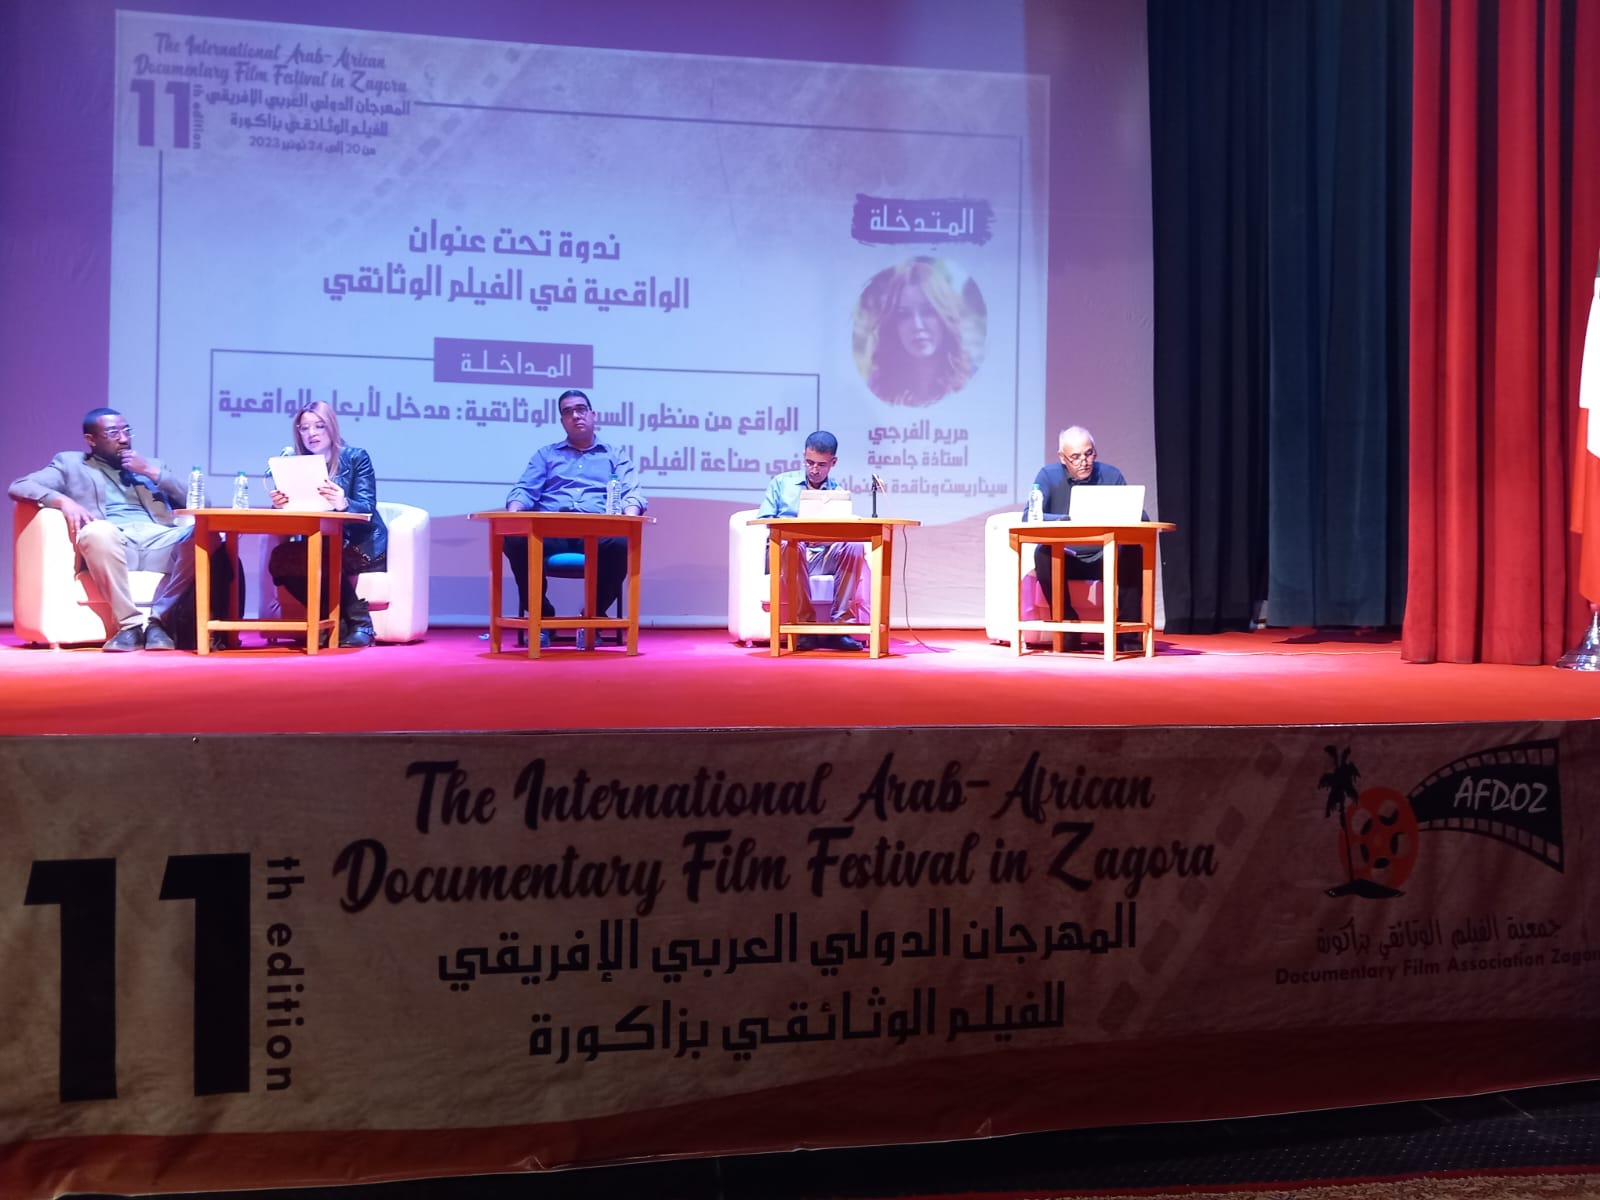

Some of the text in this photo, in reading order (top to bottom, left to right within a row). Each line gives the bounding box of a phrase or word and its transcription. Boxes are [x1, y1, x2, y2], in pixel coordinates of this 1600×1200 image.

[153, 32, 180, 54] The
[185, 34, 282, 60] International
[332, 46, 386, 70] African
[134, 53, 229, 85] Documentary
[235, 61, 268, 83] Film
[331, 73, 345, 88] in
[350, 70, 408, 97] Zagora
[129, 78, 190, 149] 11
[265, 92, 308, 110] العربي
[310, 94, 353, 113] الدولي
[355, 96, 411, 117] المهرجان
[230, 112, 389, 138] للفيلم الوثائقي بزاكورة
[249, 135, 281, 148] 2023
[345, 143, 361, 154] 20
[870, 204, 974, 236] المتدخلة
[408, 218, 620, 264] ندوة تحت عنوان
[323, 261, 689, 313] الواقعية في الفيلم الوثائقي
[460, 350, 572, 378] المداخلة
[333, 385, 381, 422] لأبعا
[386, 392, 450, 421] مدخل
[638, 402, 699, 432] منظور
[705, 411, 732, 432] من
[738, 406, 799, 435] الواقع
[868, 419, 969, 445] مريم الفرجي
[638, 445, 695, 476] الفيلم
[701, 447, 760, 472] صناعة
[867, 448, 918, 470] جامعية
[406, 751, 1155, 834] The International Arab- African
[333, 822, 1219, 917] Documentary Film Festival in Zagora
[438, 901, 1137, 992] المهرجان الدولي العربي الإفريقي
[1451, 911, 1500, 950] الفيلم
[1507, 915, 1562, 948] جمعية
[24, 852, 250, 1103] 11
[266, 856, 305, 1091] th edition
[1275, 964, 1398, 985] Documentary
[1403, 957, 1440, 977] Film
[1447, 952, 1545, 974] Association
[529, 980, 1065, 1064] للفيلم الوثائقي بزاكورة
